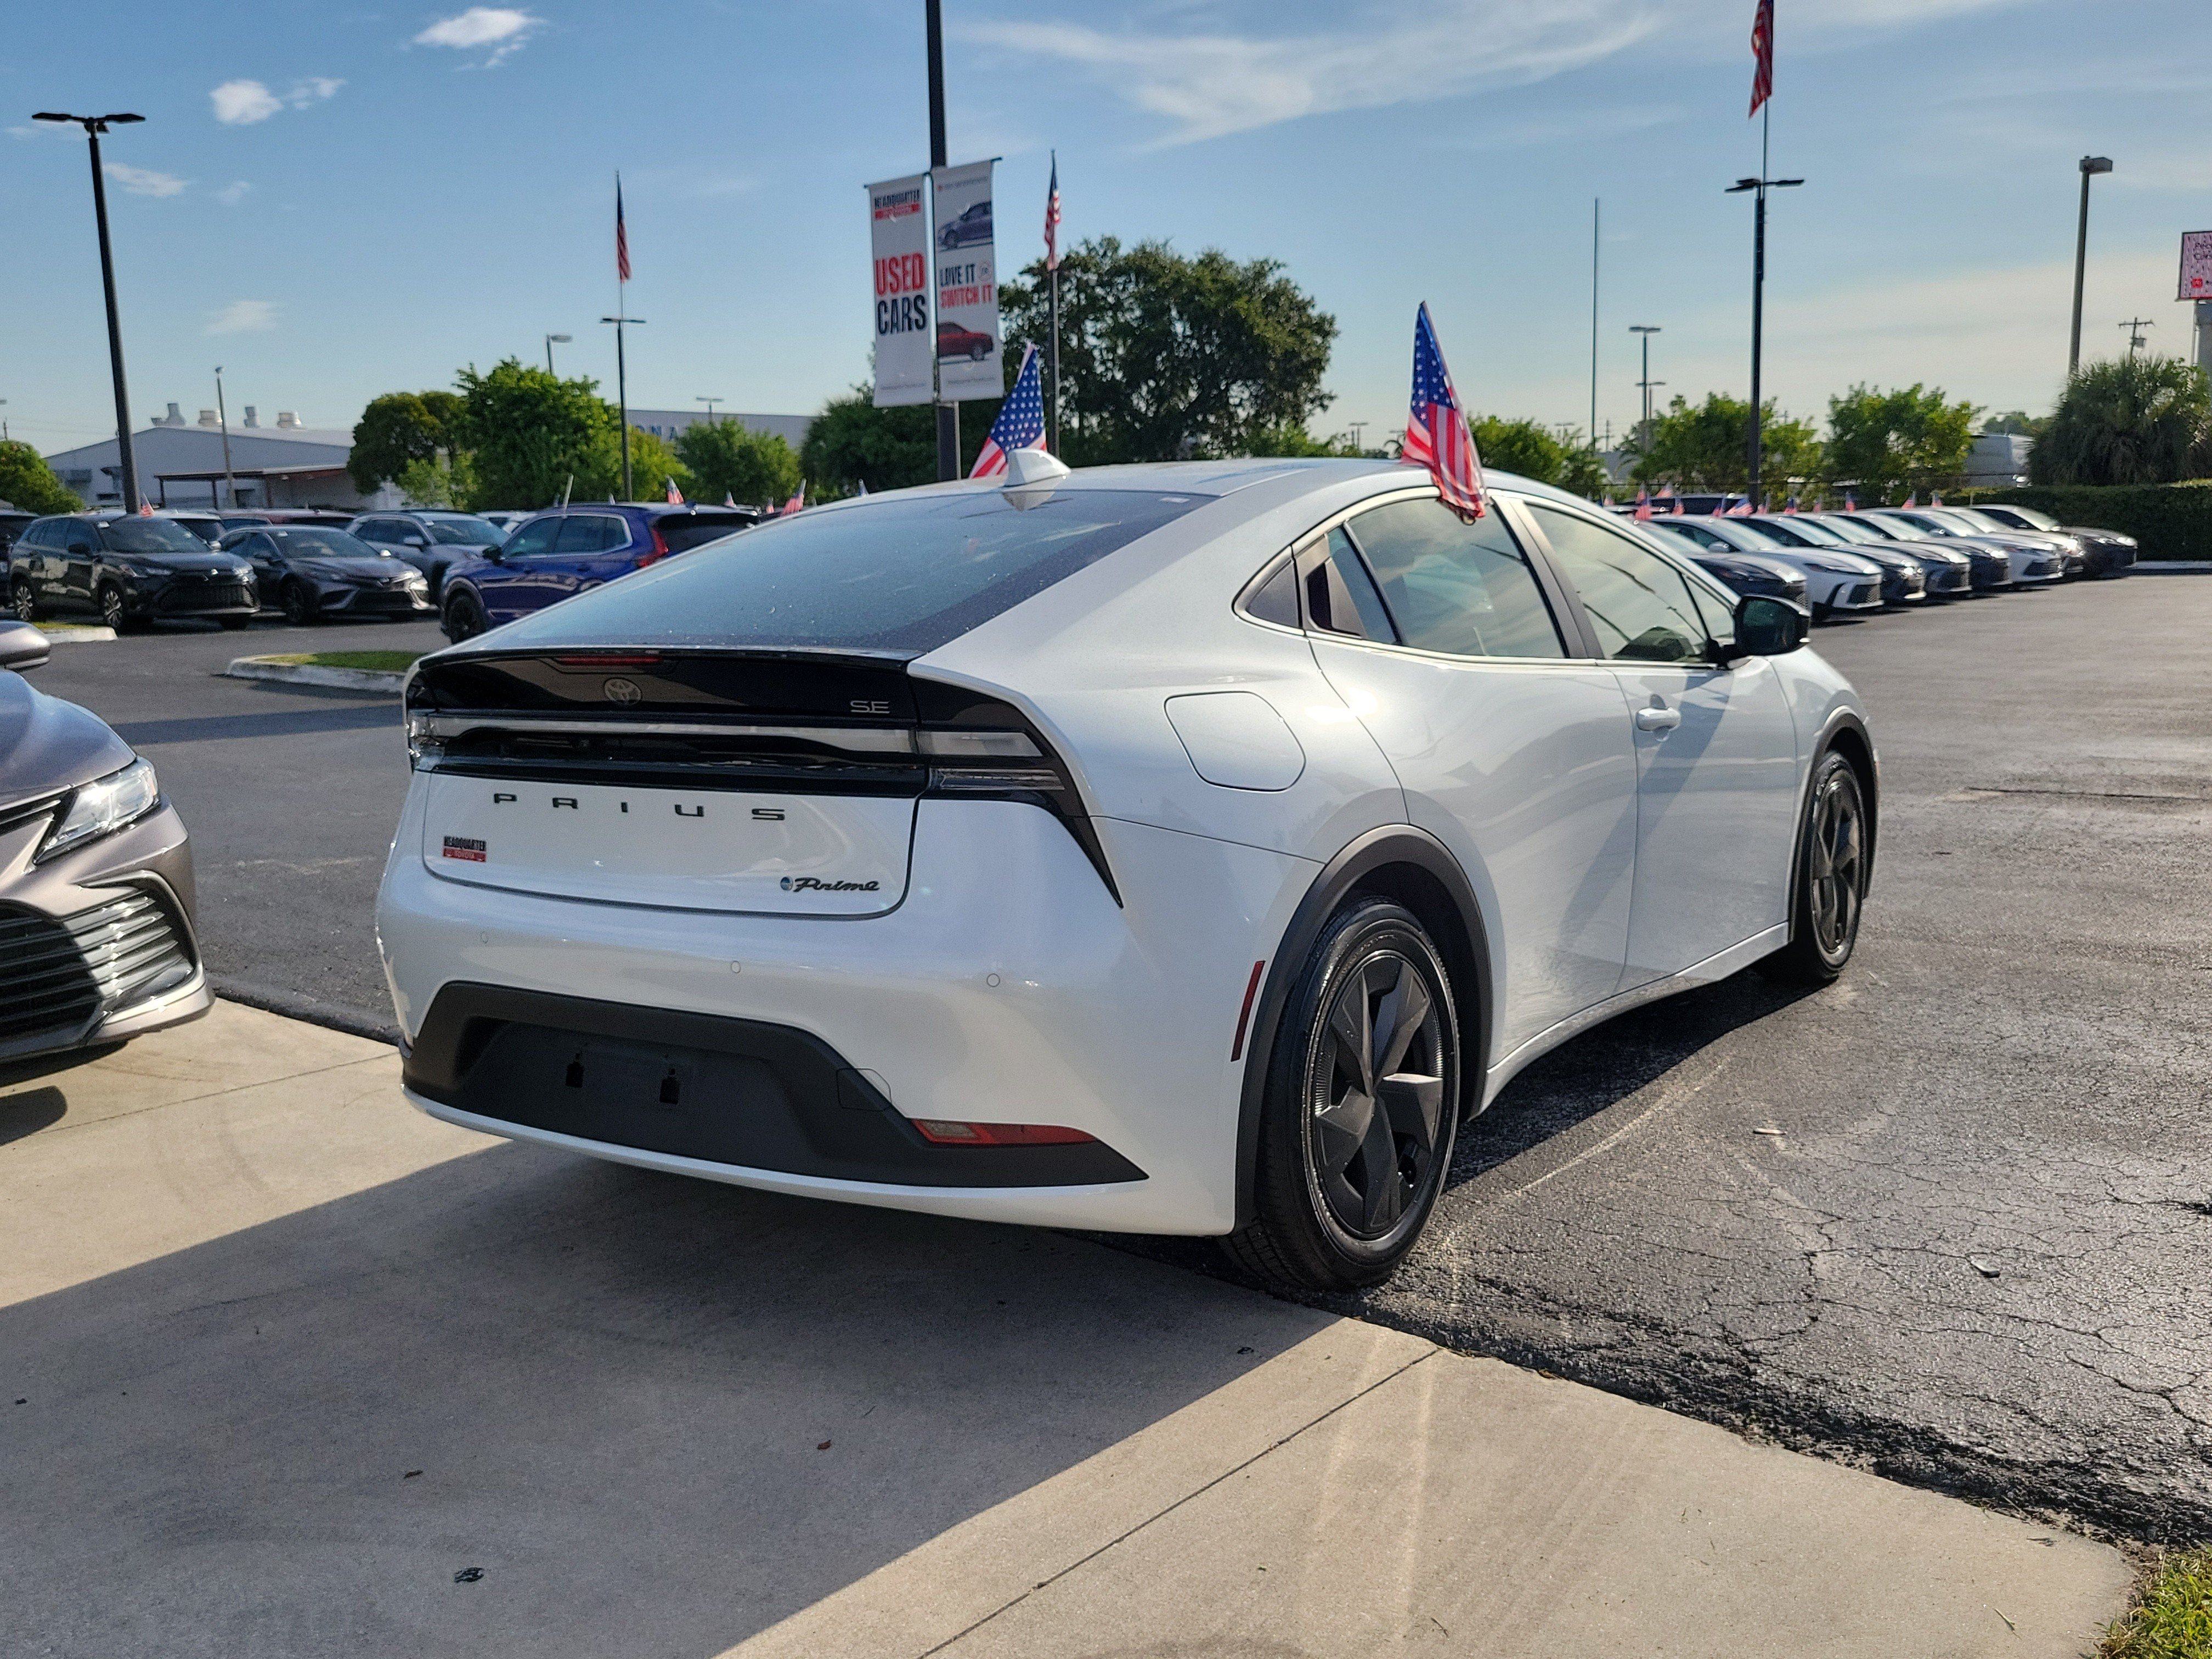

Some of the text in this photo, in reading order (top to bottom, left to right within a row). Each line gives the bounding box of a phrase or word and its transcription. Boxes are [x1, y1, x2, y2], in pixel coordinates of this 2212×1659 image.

[876, 253, 926, 296] USED
[940, 264, 975, 286] LOVE IT
[941, 284, 992, 308] SWITCH IT
[878, 295, 927, 335] CARS
[850, 700, 890, 713] SE
[493, 793, 786, 821] PRIUS
[793, 877, 880, 892] Prime
